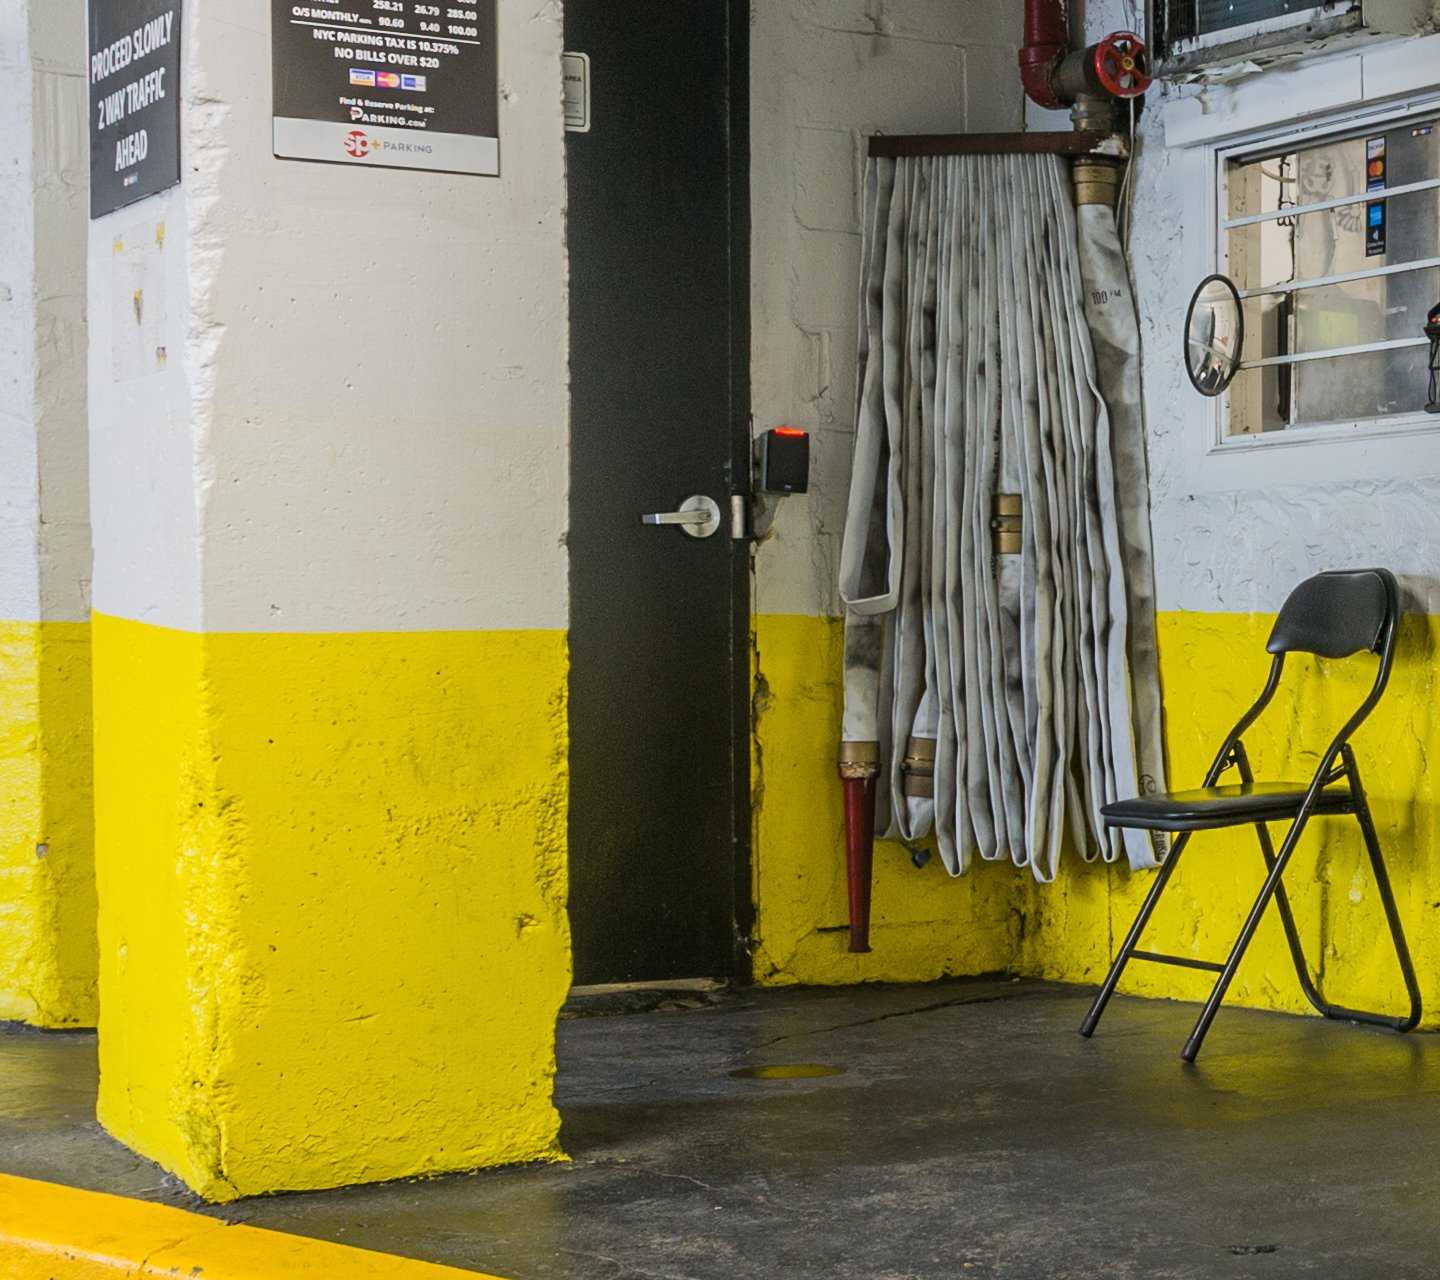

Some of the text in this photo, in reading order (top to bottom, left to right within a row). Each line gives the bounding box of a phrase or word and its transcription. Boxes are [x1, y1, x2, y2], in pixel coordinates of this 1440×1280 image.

[292, 6, 310, 18] O/S
[311, 8, 359, 23] MONTHLY
[420, 22, 440, 33] 9.40
[447, 25, 477, 37] 100.00
[446, 8, 477, 21] 285.00
[91, 10, 173, 85] PROCEED SLOWLY
[313, 29, 459, 55] NYC PARKING TAX IS 10.375%
[334, 47, 440, 69] NO BILLS OVER $20
[97, 67, 166, 130] 2 WAY TRAFFIC
[395, 102, 423, 114] Parking
[114, 129, 148, 172] AHEAD
[383, 140, 433, 154] PARKING
